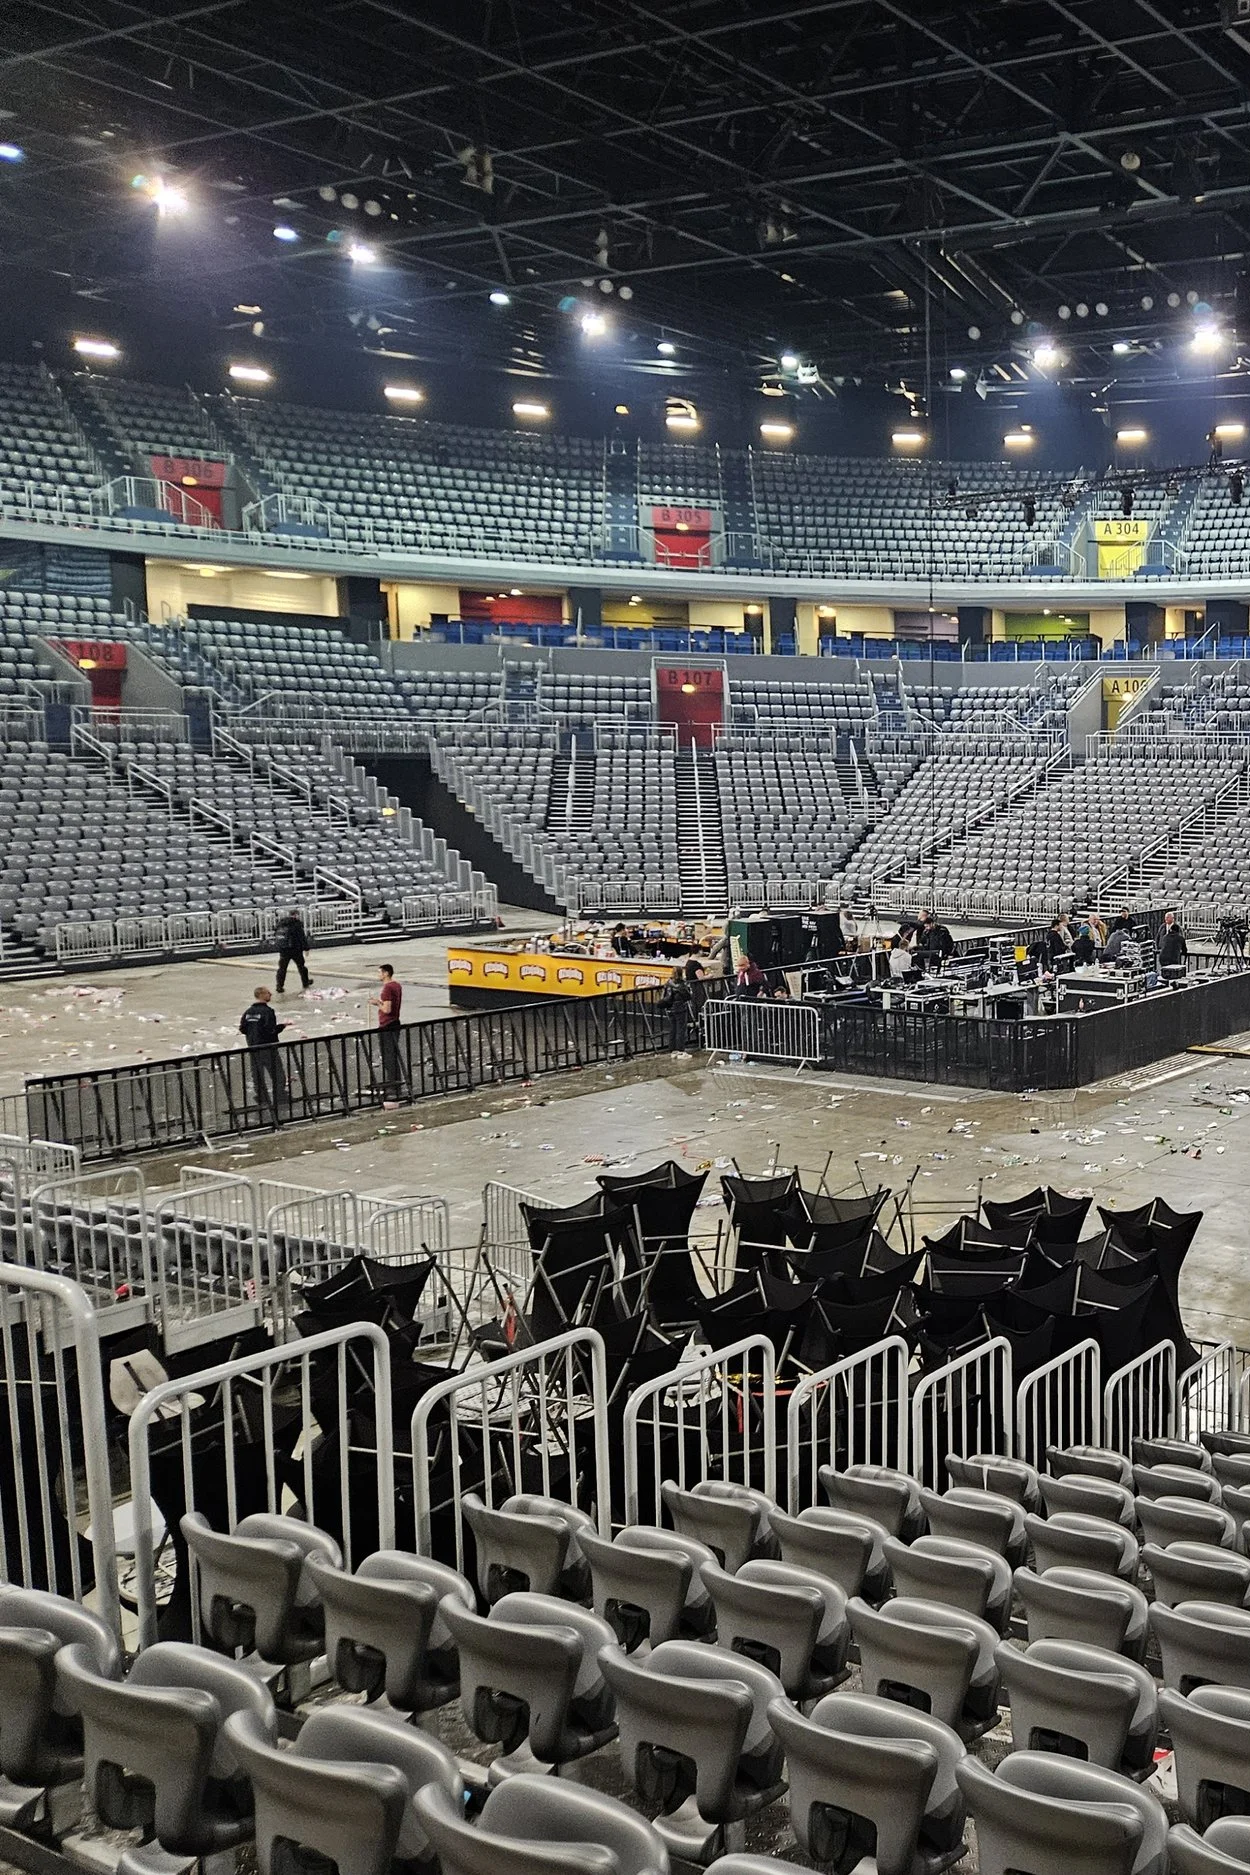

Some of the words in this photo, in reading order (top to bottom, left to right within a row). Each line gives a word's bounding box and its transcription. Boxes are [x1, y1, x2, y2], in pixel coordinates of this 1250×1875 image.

[661, 510, 671, 522] B
[677, 510, 703, 523] 305
[1103, 523, 1112, 535] A
[1116, 522, 1139, 535] 304
[78, 643, 113, 661] 108
[668, 671, 678, 685] B
[683, 671, 711, 686] 107
[1111, 680, 1120, 693] A
